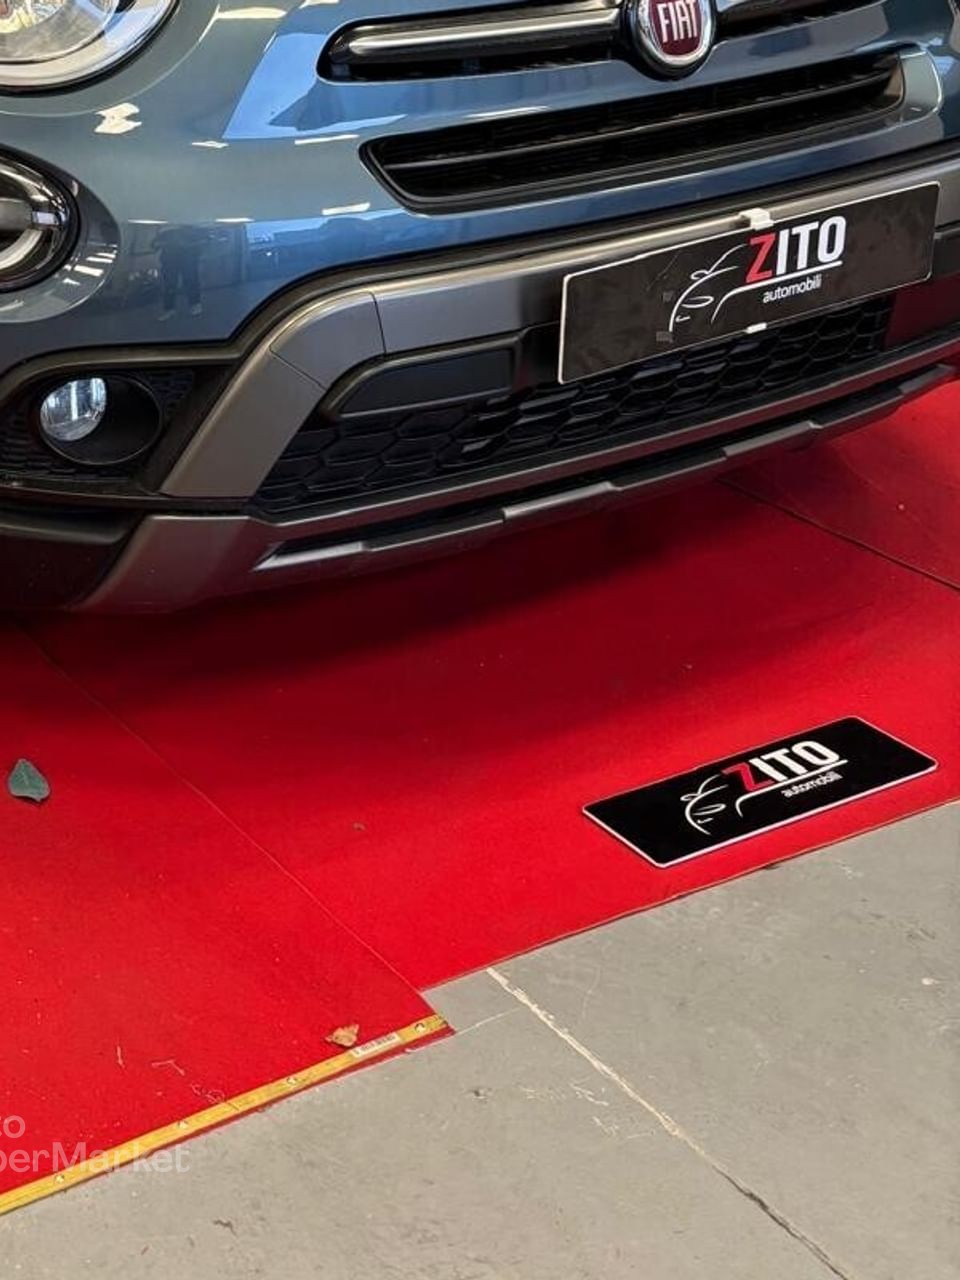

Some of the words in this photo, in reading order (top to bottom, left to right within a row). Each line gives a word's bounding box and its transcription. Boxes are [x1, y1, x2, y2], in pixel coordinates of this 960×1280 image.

[745, 215, 846, 284] ZITO
[763, 273, 822, 304] automobili
[721, 740, 840, 791] ZITO
[781, 770, 843, 798] automobili
